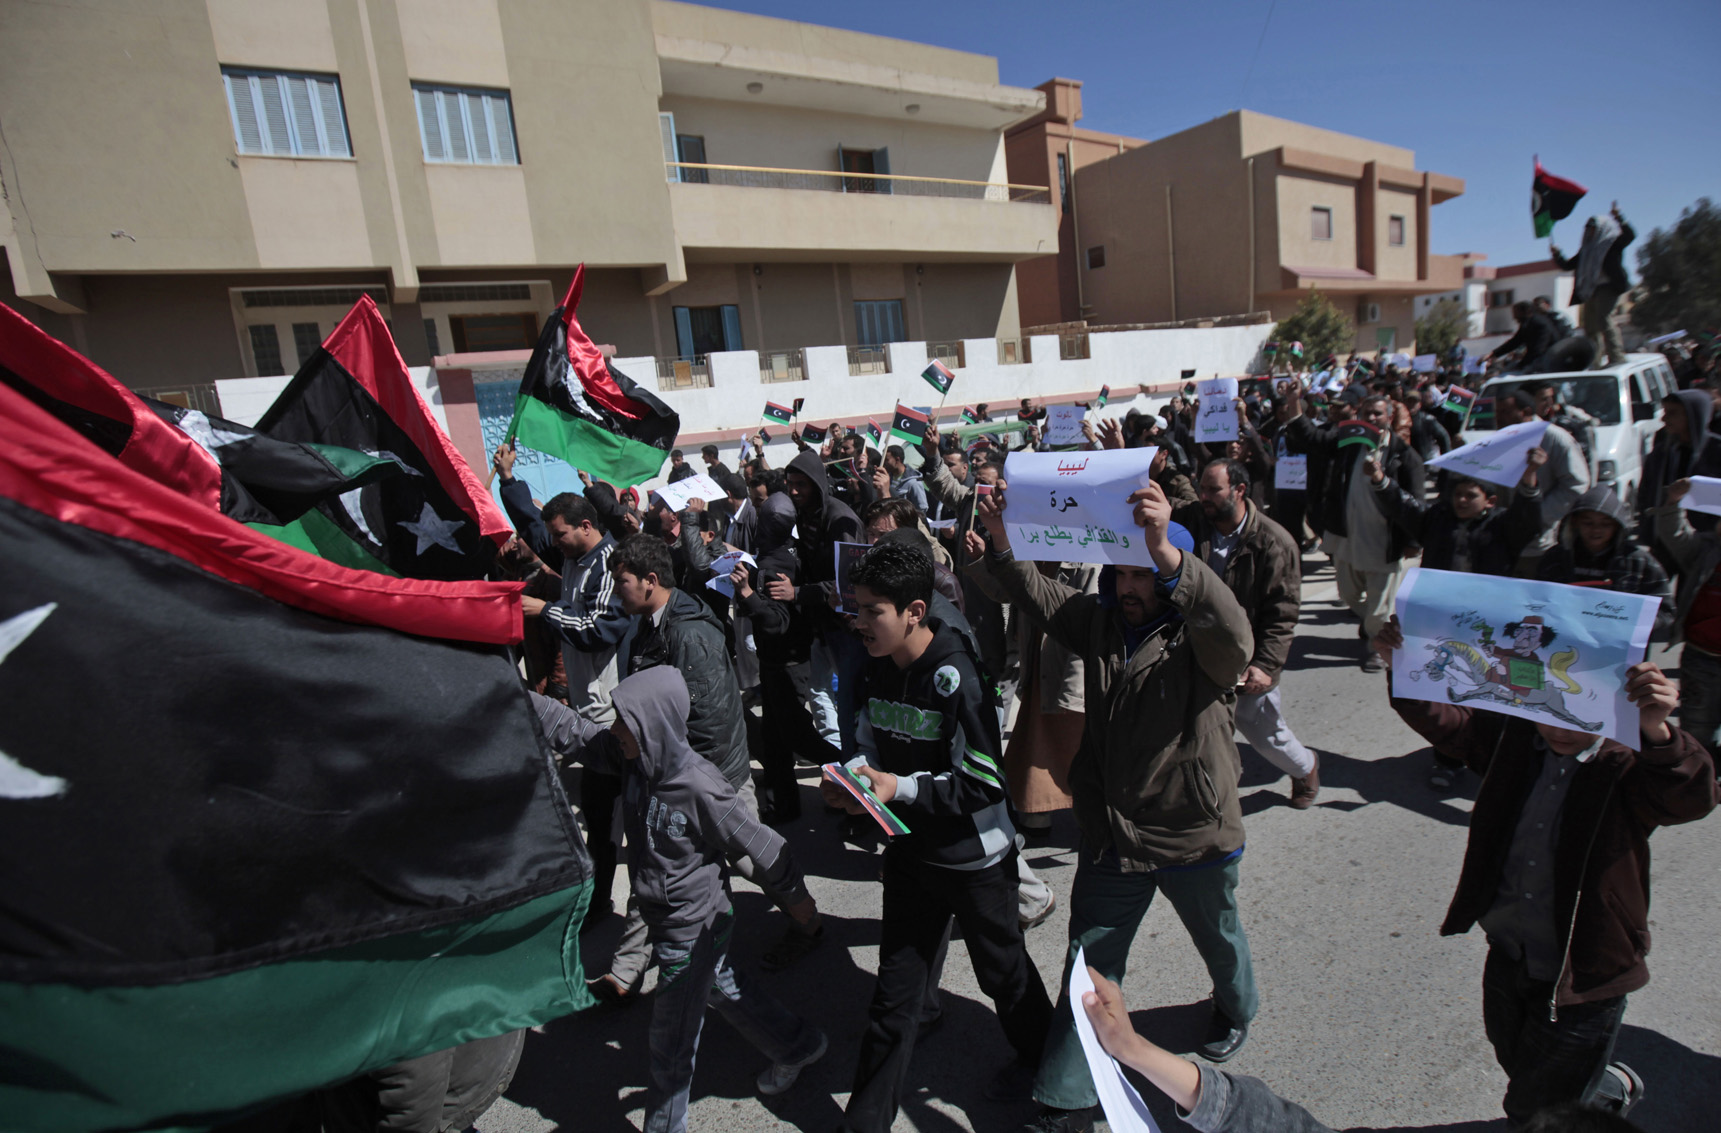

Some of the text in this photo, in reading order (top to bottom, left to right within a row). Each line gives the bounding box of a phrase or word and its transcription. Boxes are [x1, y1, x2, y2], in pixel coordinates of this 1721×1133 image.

[1057, 457, 1089, 476] ليبيا
[1050, 490, 1078, 512] حرة
[1019, 526, 1040, 544] برا
[1044, 524, 1073, 546] يطلع
[936, 672, 953, 693] 72
